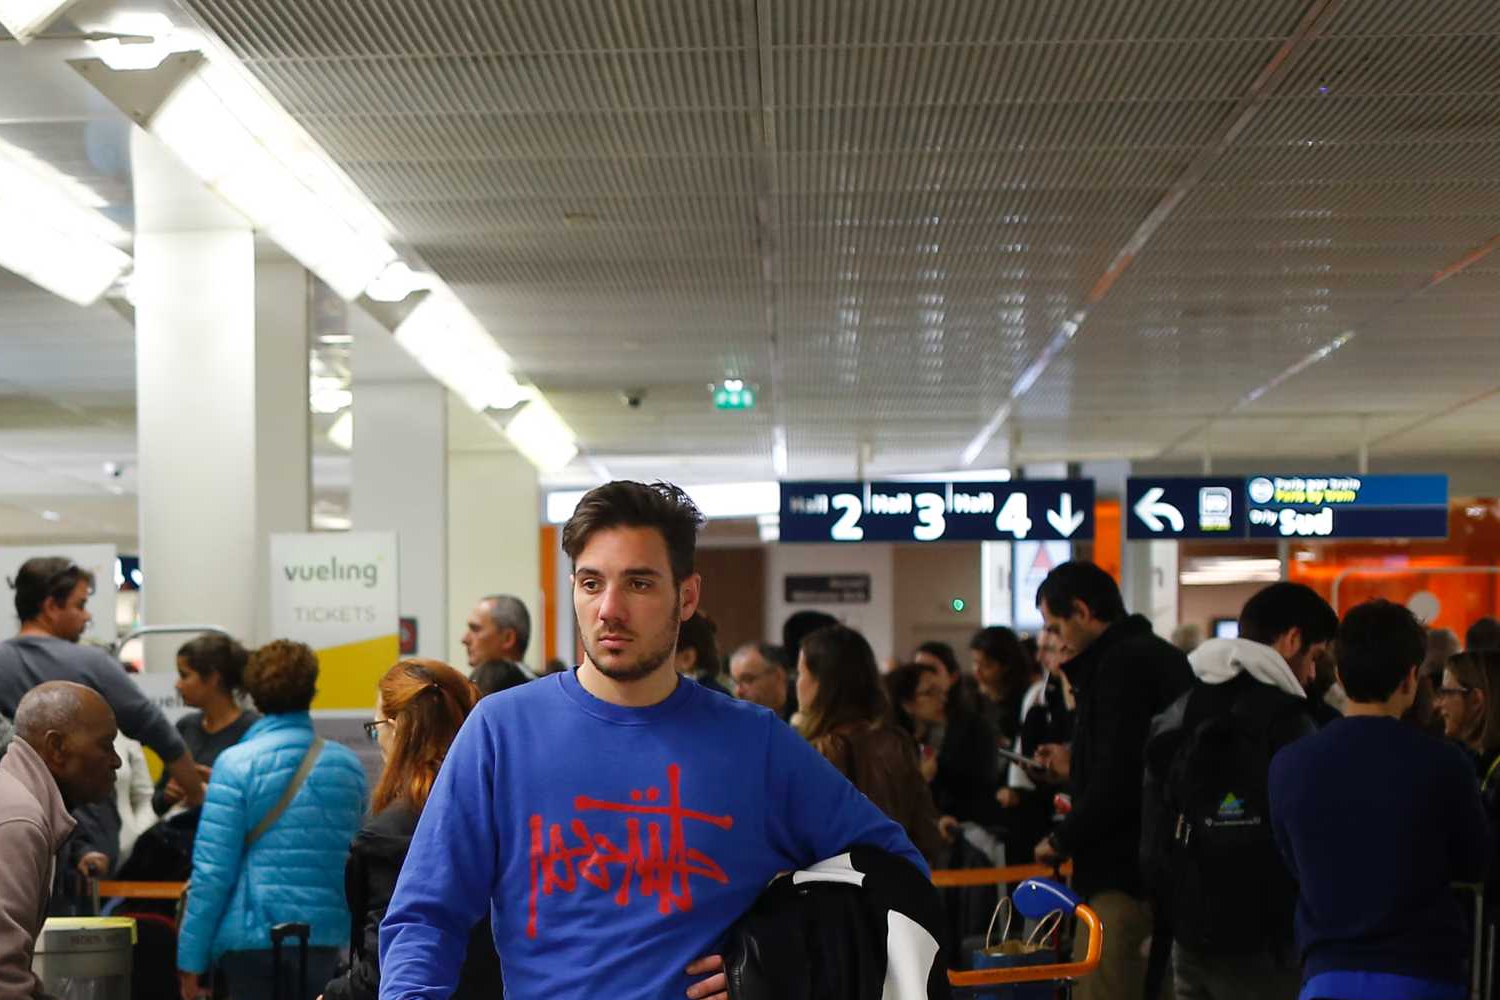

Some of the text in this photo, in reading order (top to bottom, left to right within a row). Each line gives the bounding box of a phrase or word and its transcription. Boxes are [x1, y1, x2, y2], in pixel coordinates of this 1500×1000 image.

[831, 493, 864, 541] 2
[914, 492, 945, 541] 3
[996, 492, 1032, 539] 4
[1279, 507, 1333, 536] Sud
[284, 556, 377, 588] vueling
[293, 605, 376, 624] TICKETS
